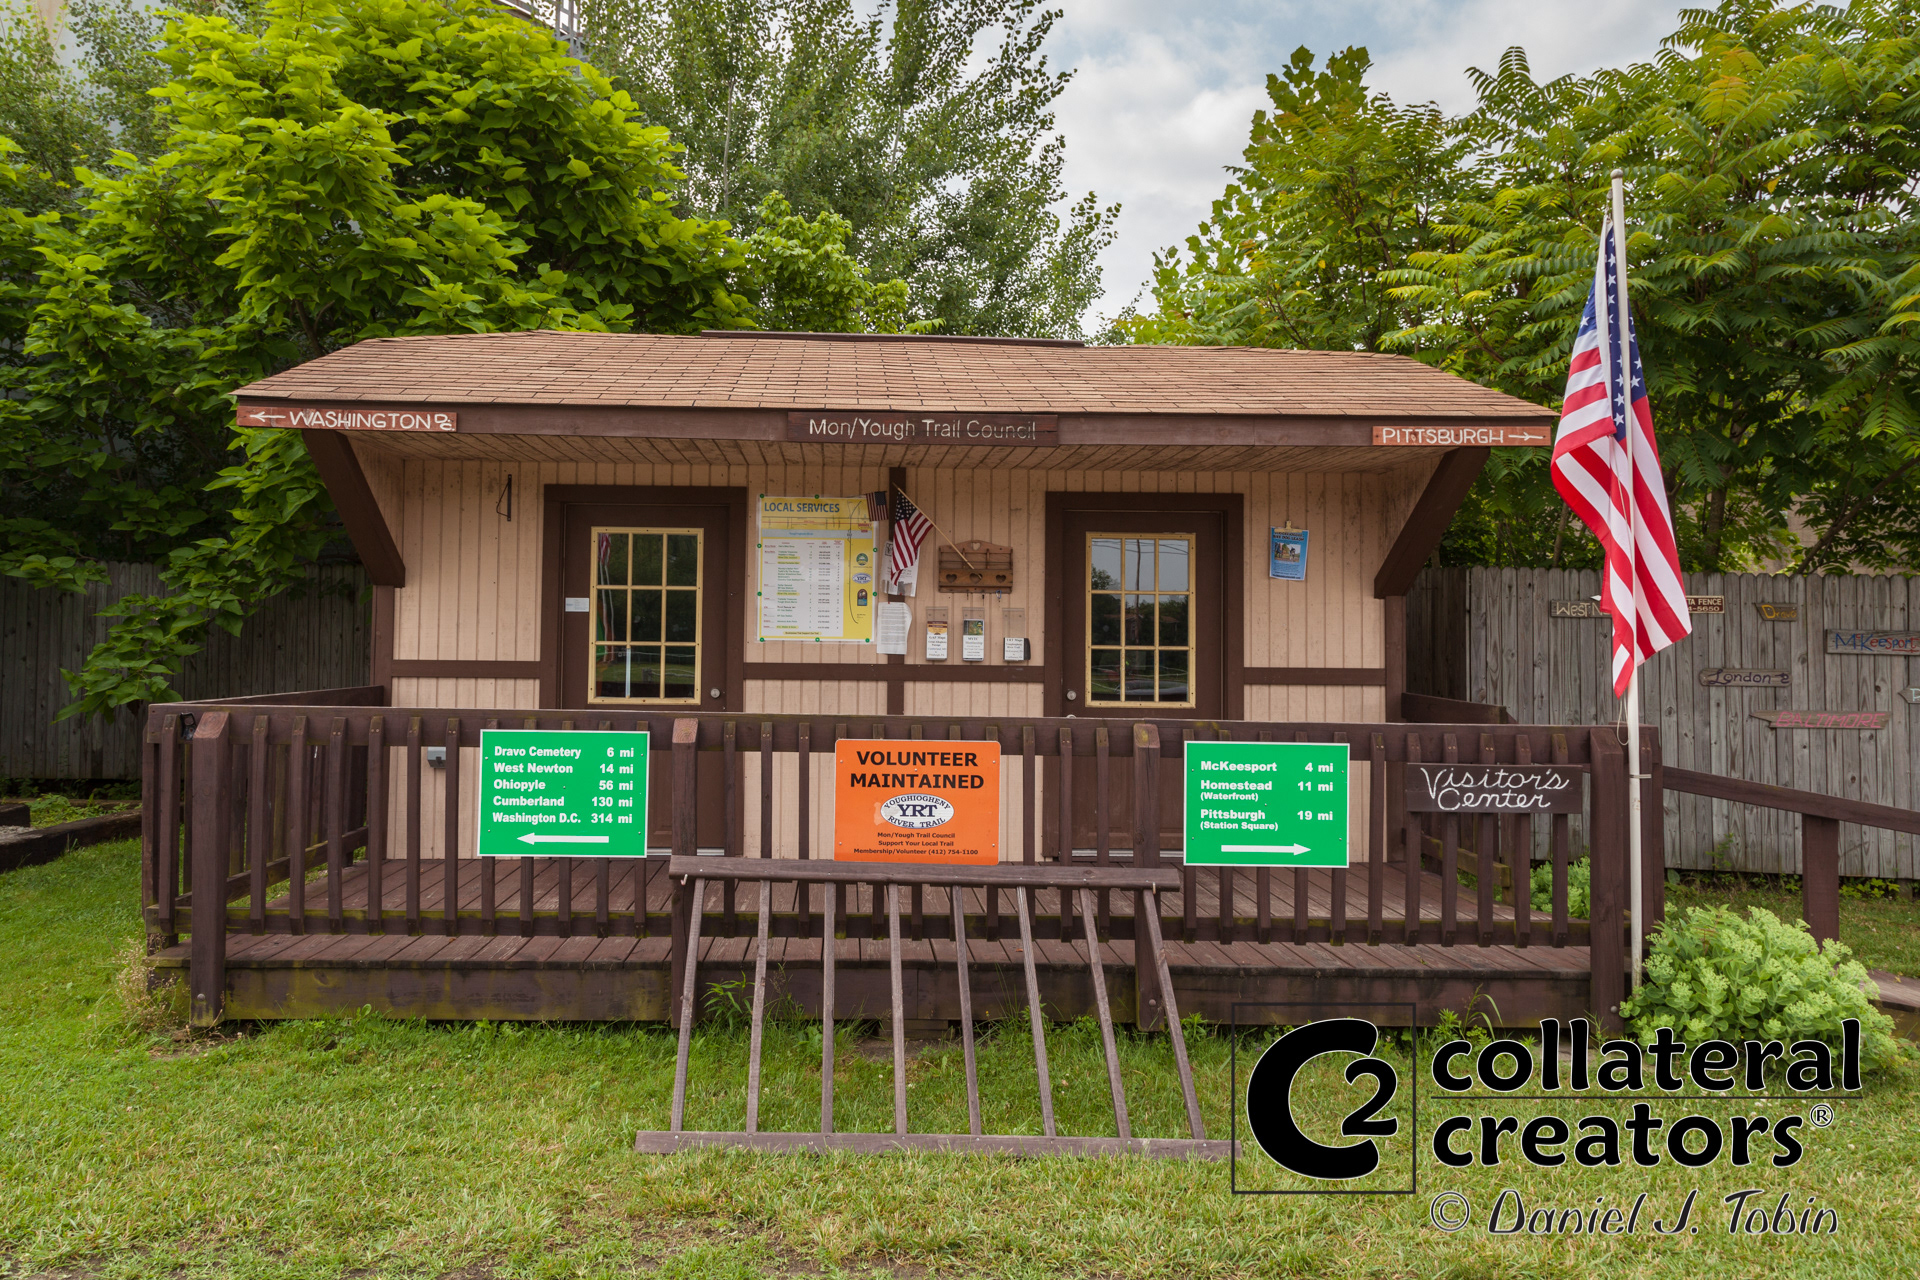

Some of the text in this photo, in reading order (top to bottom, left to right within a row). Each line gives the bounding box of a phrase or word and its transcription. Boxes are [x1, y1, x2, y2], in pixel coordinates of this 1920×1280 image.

[290, 411, 430, 429] WASHINGTON
[809, 418, 1036, 440] Mon/Yough Trail Council
[1382, 428, 1504, 444] PITTSBURGH
[764, 502, 840, 512] LOCAL SERVICES
[1761, 604, 1797, 618] Dravo
[1708, 669, 1771, 684] London
[1775, 711, 1885, 728] BALTIMORE
[494, 746, 634, 759] Dravo Cemetery 6 mi
[856, 751, 978, 766] VOLUNTEER
[494, 762, 634, 774] West Newton 14 mi
[1200, 761, 1334, 773] McKeesport 4 mi
[494, 779, 633, 792] Ohiopyle 56 mi
[850, 773, 984, 789] MAINTAINED
[1200, 780, 1333, 791] Homestead 11 mi
[1420, 767, 1570, 799] Visitor's
[493, 796, 633, 807] Cumberland 130 mi
[884, 795, 951, 809] YOUGHIOGHENY
[1200, 792, 1258, 801] (Waterfront)
[1438, 788, 1551, 810] Center
[897, 804, 938, 817] YRT
[1200, 809, 1333, 821] Pittsburgh 19 mi
[492, 812, 632, 825] Washington D.C. 314 mi
[888, 816, 946, 828] RIVER TRAIL
[1200, 821, 1278, 831] (Station Square)
